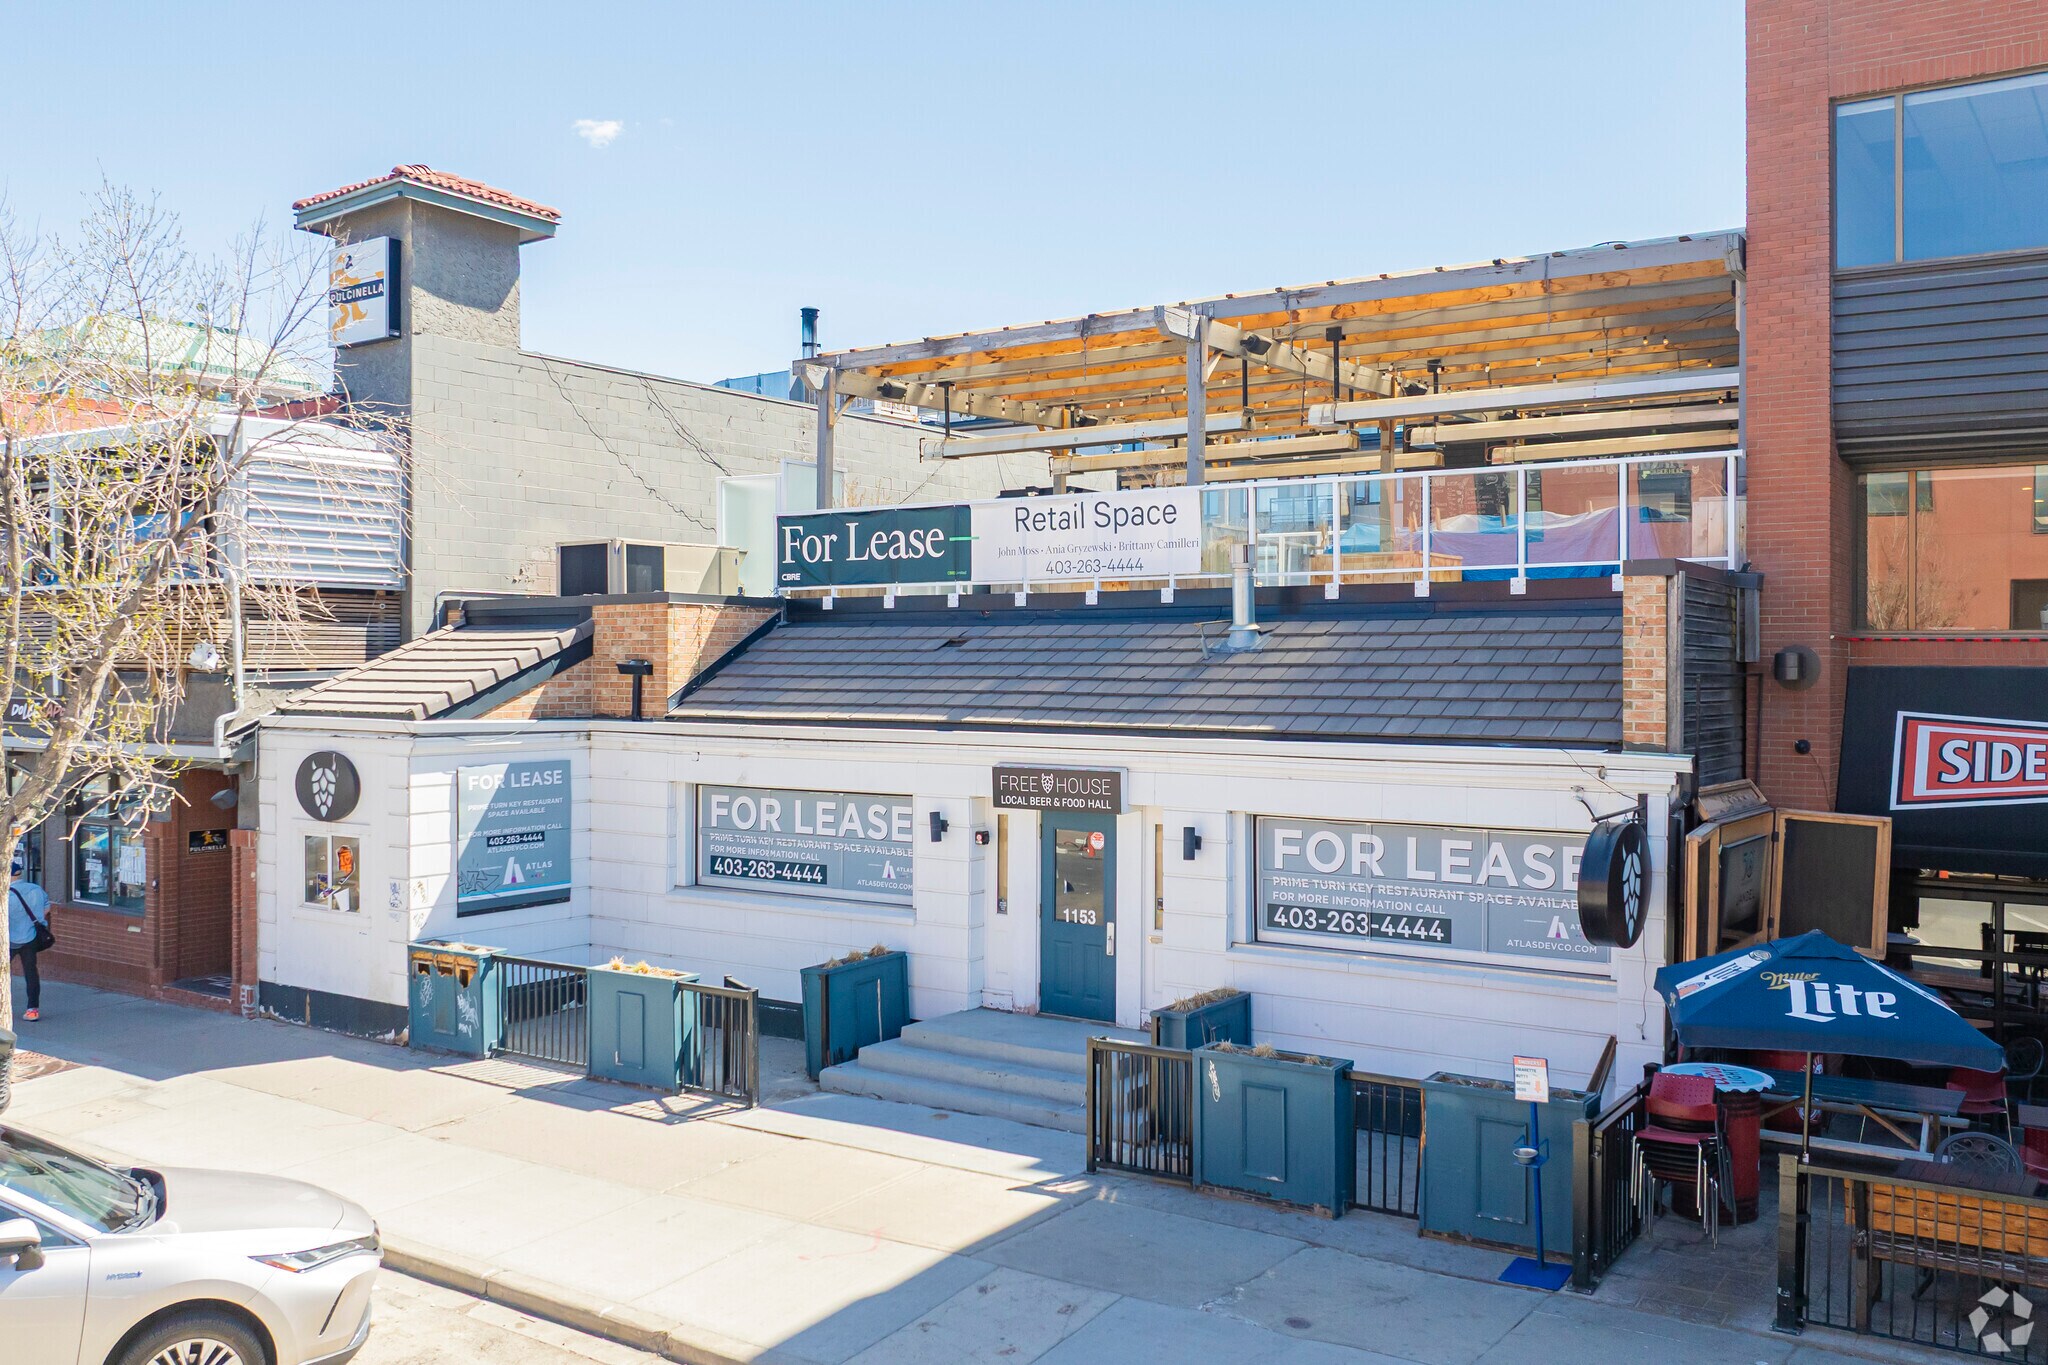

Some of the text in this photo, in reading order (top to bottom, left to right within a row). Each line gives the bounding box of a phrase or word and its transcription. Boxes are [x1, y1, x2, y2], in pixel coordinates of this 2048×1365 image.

[330, 283, 384, 302] PULCINELLA
[1015, 501, 1177, 534] Retail Space
[782, 522, 945, 564] For Lease
[998, 537, 1199, 558] John Moss Ania Gryzewski Brittany Camilleri
[1045, 557, 1144, 575] 403-263-4444
[781, 573, 801, 581] CBRE
[1938, 739, 2047, 783] SIDE
[468, 770, 562, 791] FOR LEASE
[1000, 775, 1111, 795] FREE HOUSE
[523, 798, 563, 806] RESTAURANT
[1001, 795, 1112, 809] LOCAL BEER & FOOD HALL
[488, 807, 546, 818] SPACE AVAILABLE
[711, 794, 913, 842] FOR LEASE
[489, 833, 543, 845] 403-263-4444
[503, 825, 546, 835] INFORMATION
[710, 833, 913, 857] PRIME TURN KEY RESTAURANT SPACE AVAILABLE
[710, 845, 820, 862] FOR MORE INFORMATION CALL
[526, 861, 553, 870] ATLAS
[1274, 829, 1584, 891] FOR LEASE
[714, 858, 823, 883] 403-263-4444
[1273, 877, 1578, 910] PRIME TURN KEY RESTAURANT SPACE AVAILAB
[1273, 892, 1446, 915] FOR MORE INFORMATION CALL
[1063, 908, 1096, 925] 1153
[1273, 906, 1444, 941] 403-263-4444
[1507, 939, 1597, 954] ATLASDEVCO.COM
[1760, 972, 1821, 990] Miller
[1784, 978, 1897, 1023] Lite
